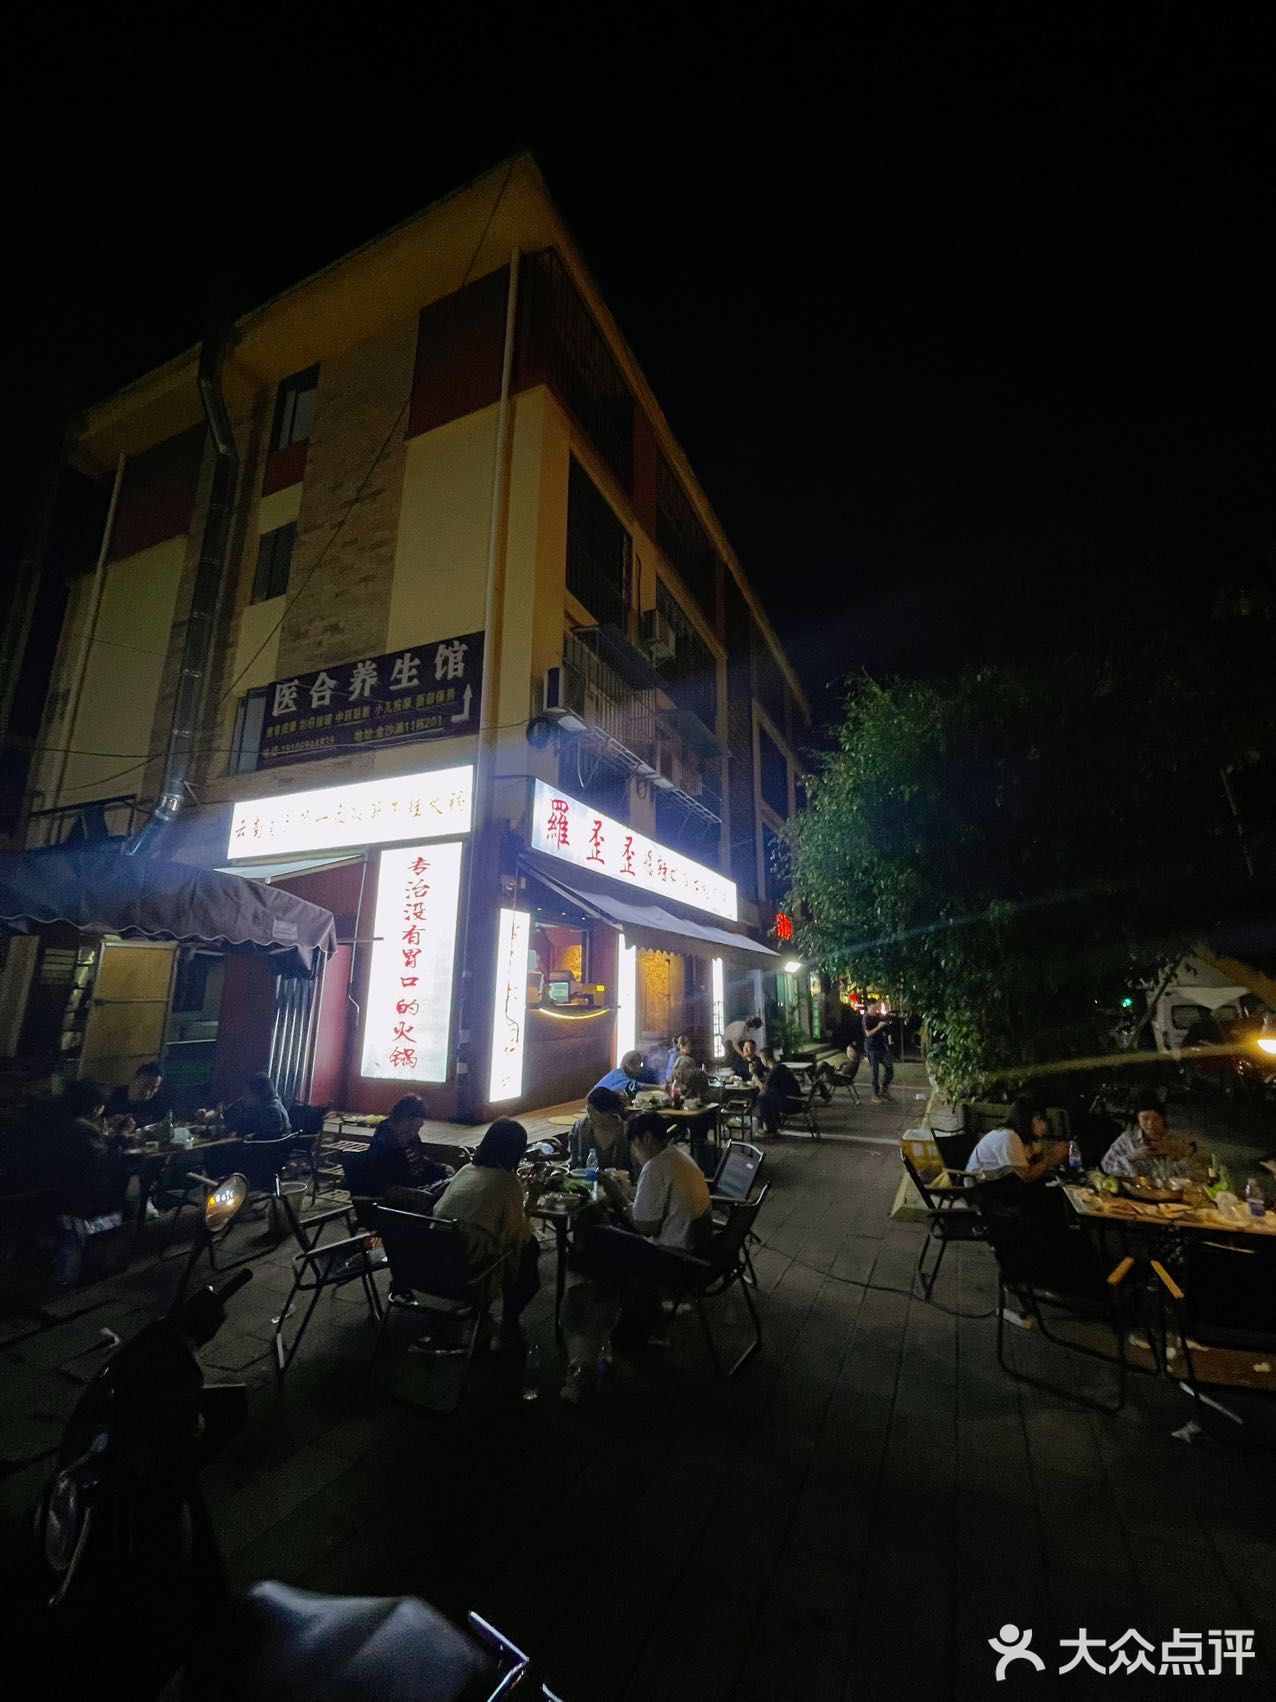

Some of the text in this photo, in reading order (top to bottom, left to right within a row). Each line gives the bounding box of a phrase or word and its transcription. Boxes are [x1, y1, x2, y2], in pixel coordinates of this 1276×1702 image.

[273, 640, 468, 716] 医合养生馆
[547, 798, 636, 877] 羅歪歪
[389, 856, 432, 1069] 专治没有胃口的火锅
